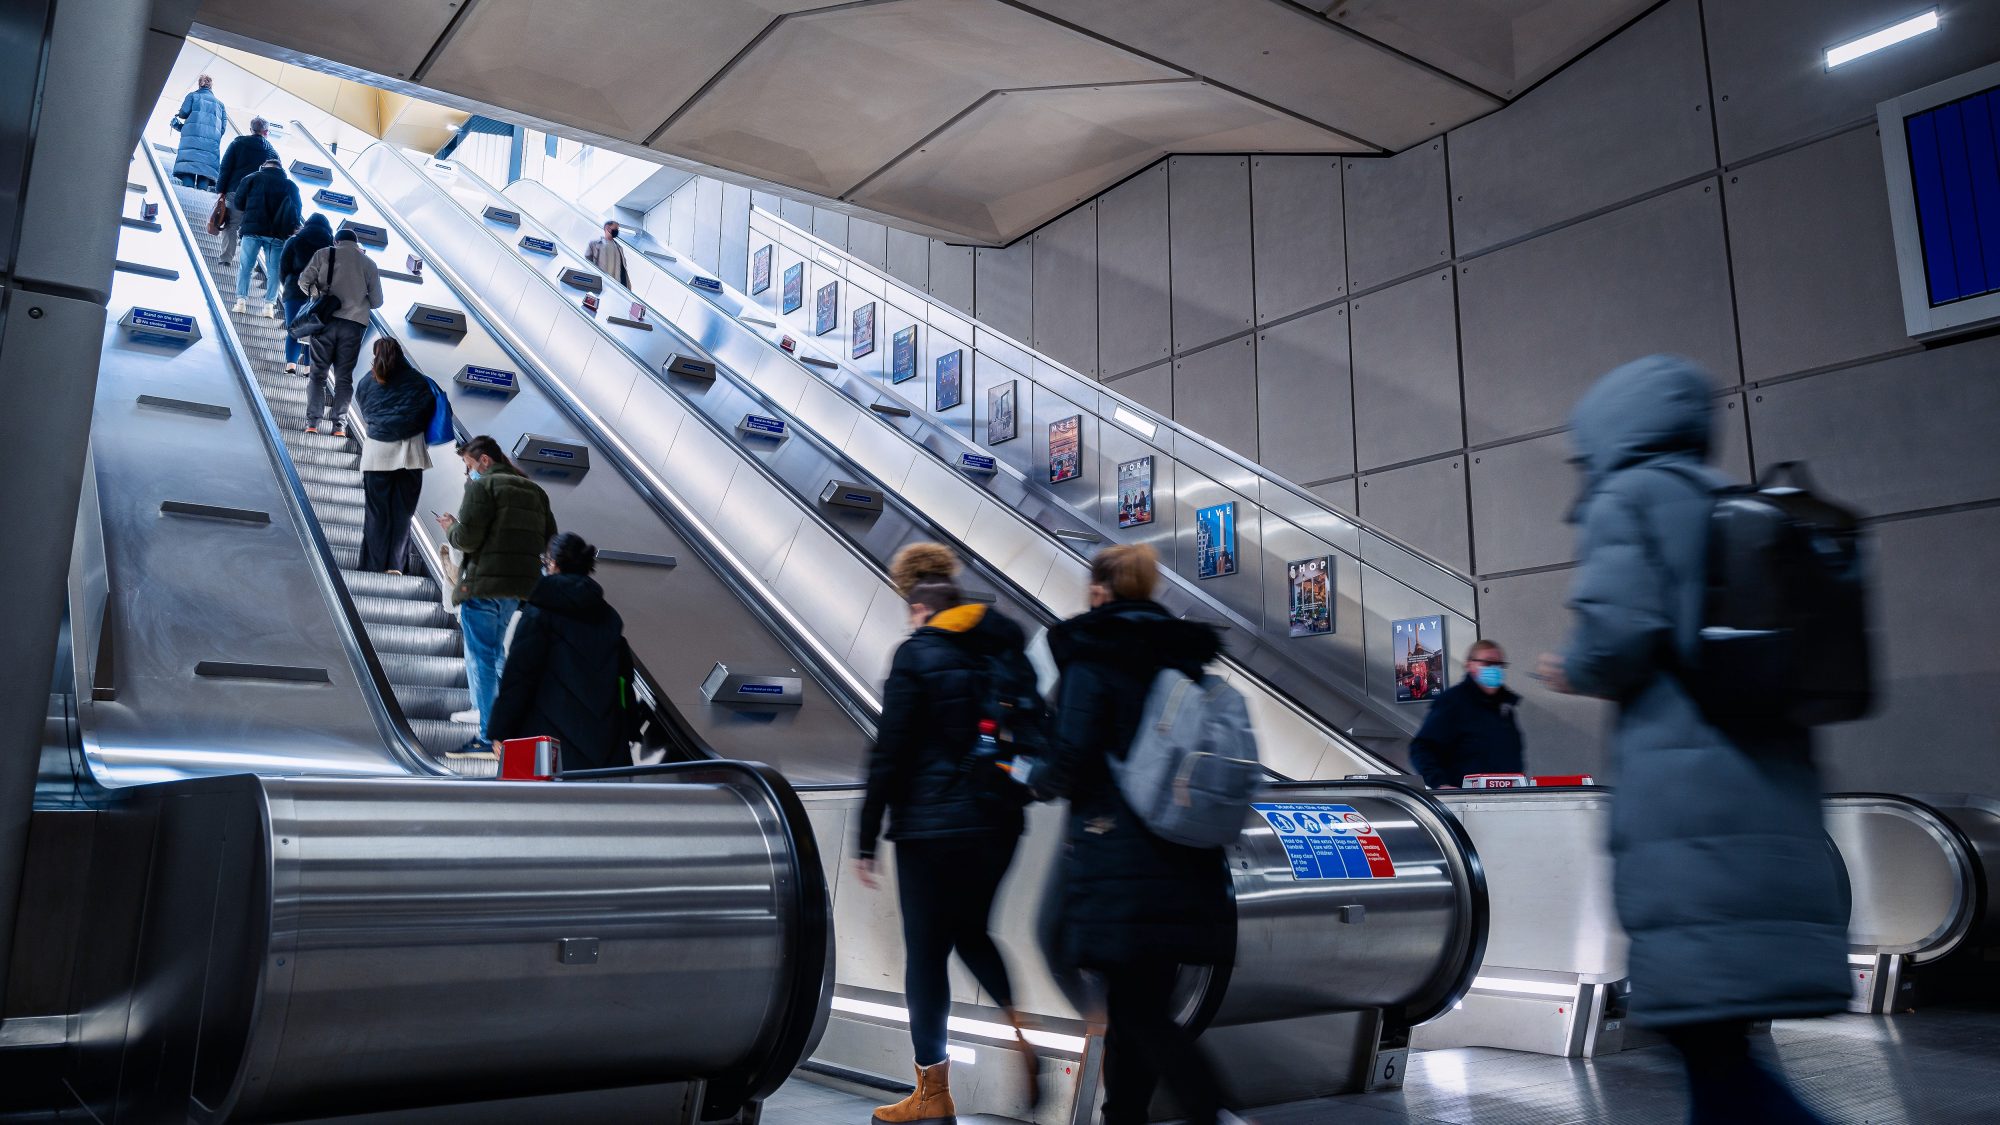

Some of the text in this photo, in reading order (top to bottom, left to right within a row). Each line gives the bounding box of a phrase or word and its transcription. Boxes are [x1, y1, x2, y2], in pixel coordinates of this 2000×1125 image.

[1121, 460, 1148, 472] WORK
[1200, 506, 1230, 520] LIVE
[1290, 561, 1325, 573] SHOP
[1397, 621, 1436, 633] PLAY
[1384, 1057, 1395, 1080] 6
